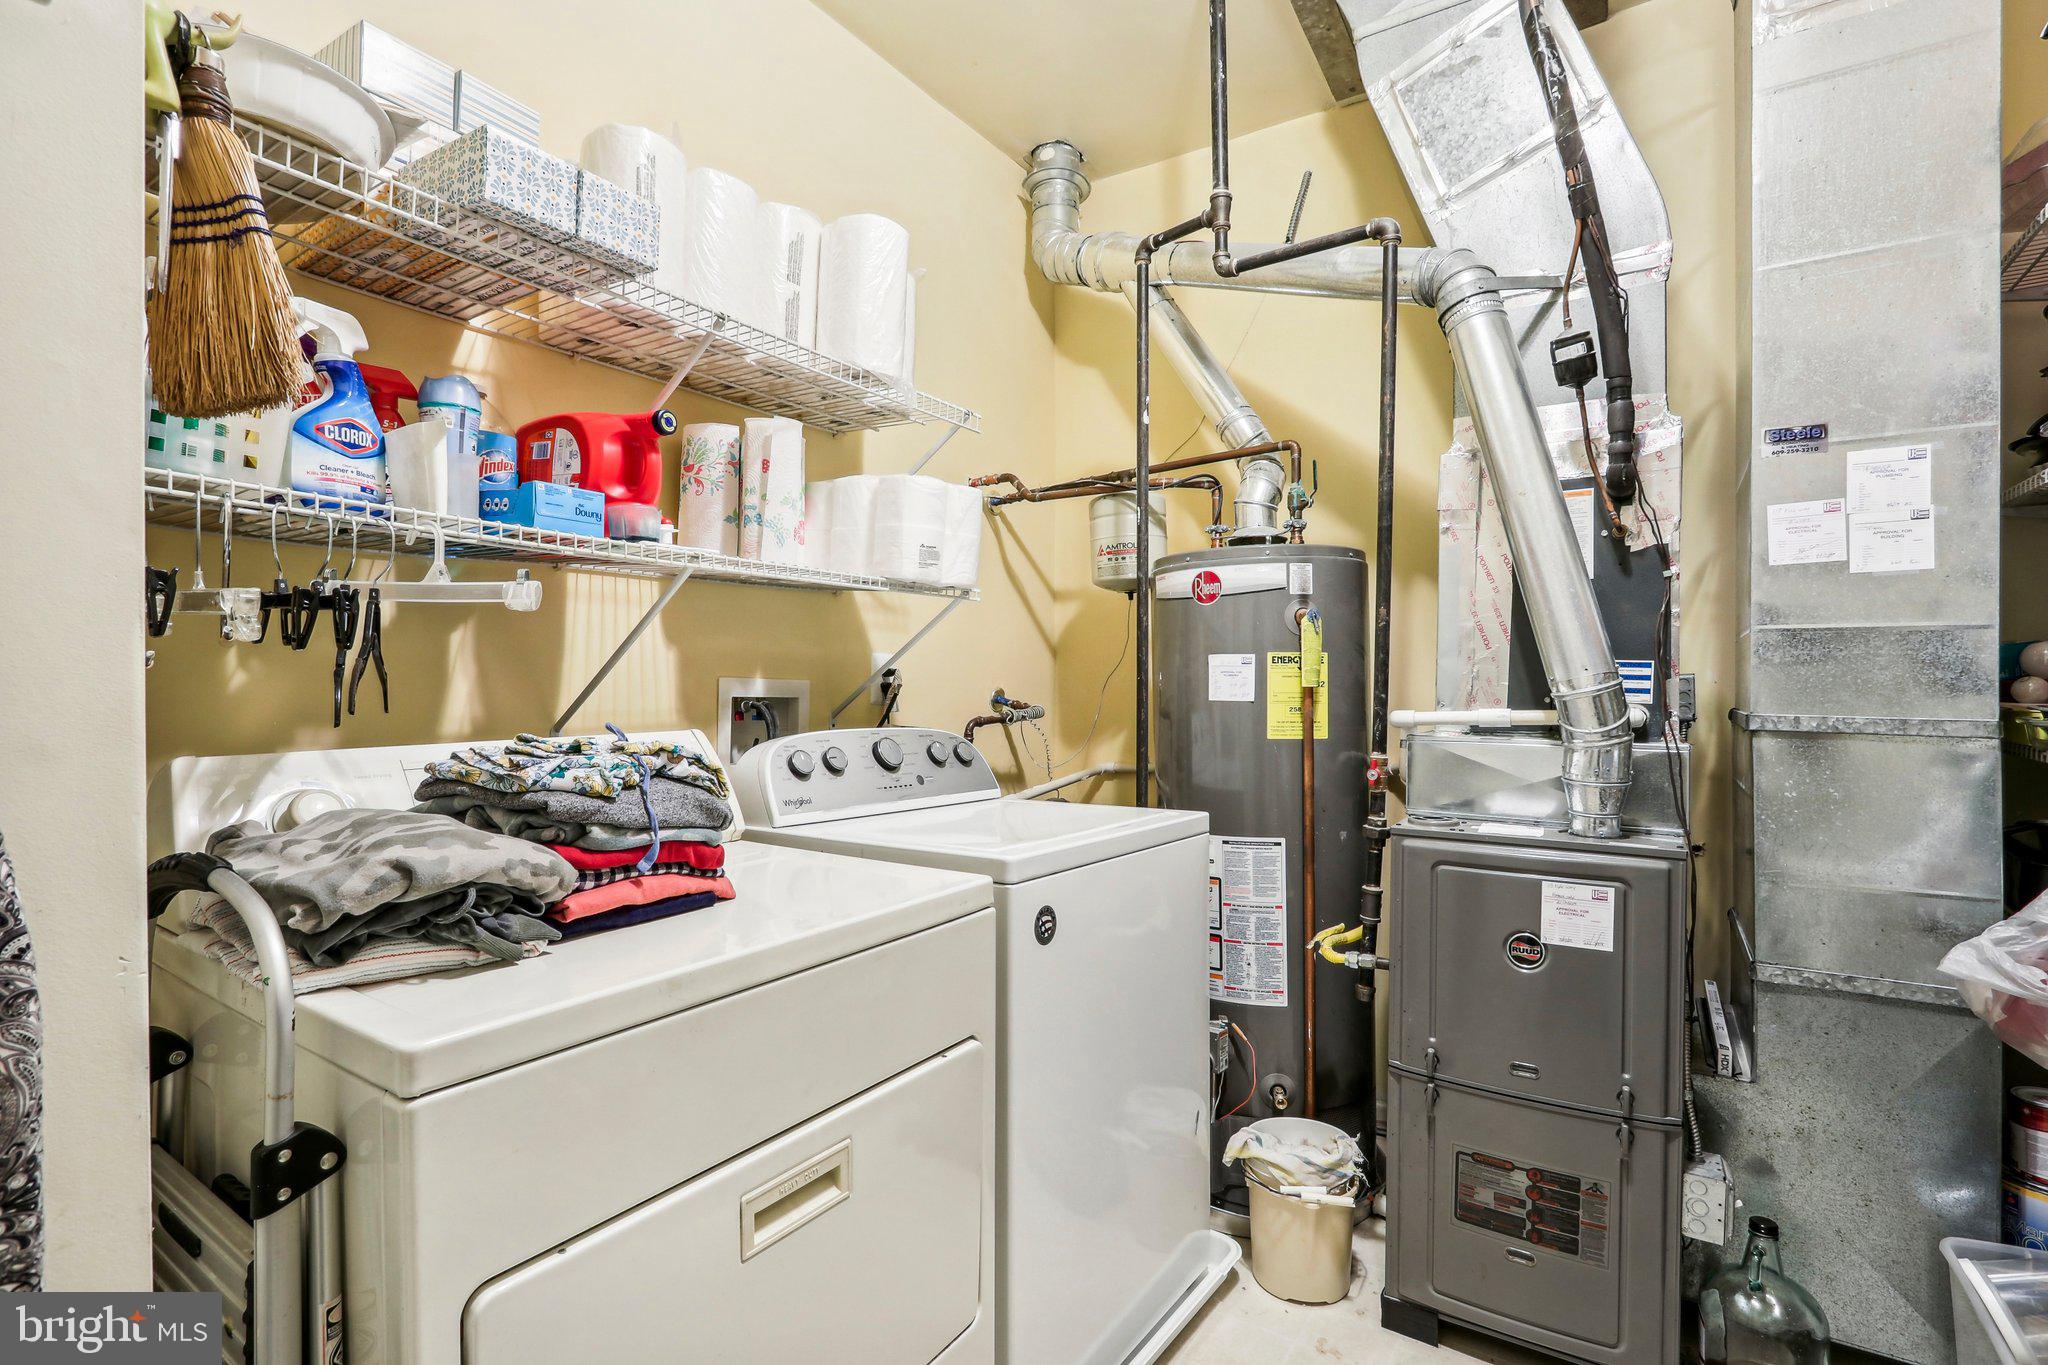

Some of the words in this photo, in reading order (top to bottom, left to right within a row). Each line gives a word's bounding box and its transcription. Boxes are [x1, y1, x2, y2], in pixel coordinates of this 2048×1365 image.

[324, 424, 373, 448] CLOROX
[1769, 427, 1823, 442] Steele
[1771, 446, 1819, 456] 609-259-3210
[319, 464, 348, 475] Cleaner
[356, 470, 376, 481] Bleach
[575, 504, 602, 522] Downy
[1194, 571, 1221, 600] Rheem
[783, 796, 813, 809] Whirlpool
[1511, 946, 1540, 956] RUUD
[1721, 1053, 1730, 1072] HDX
